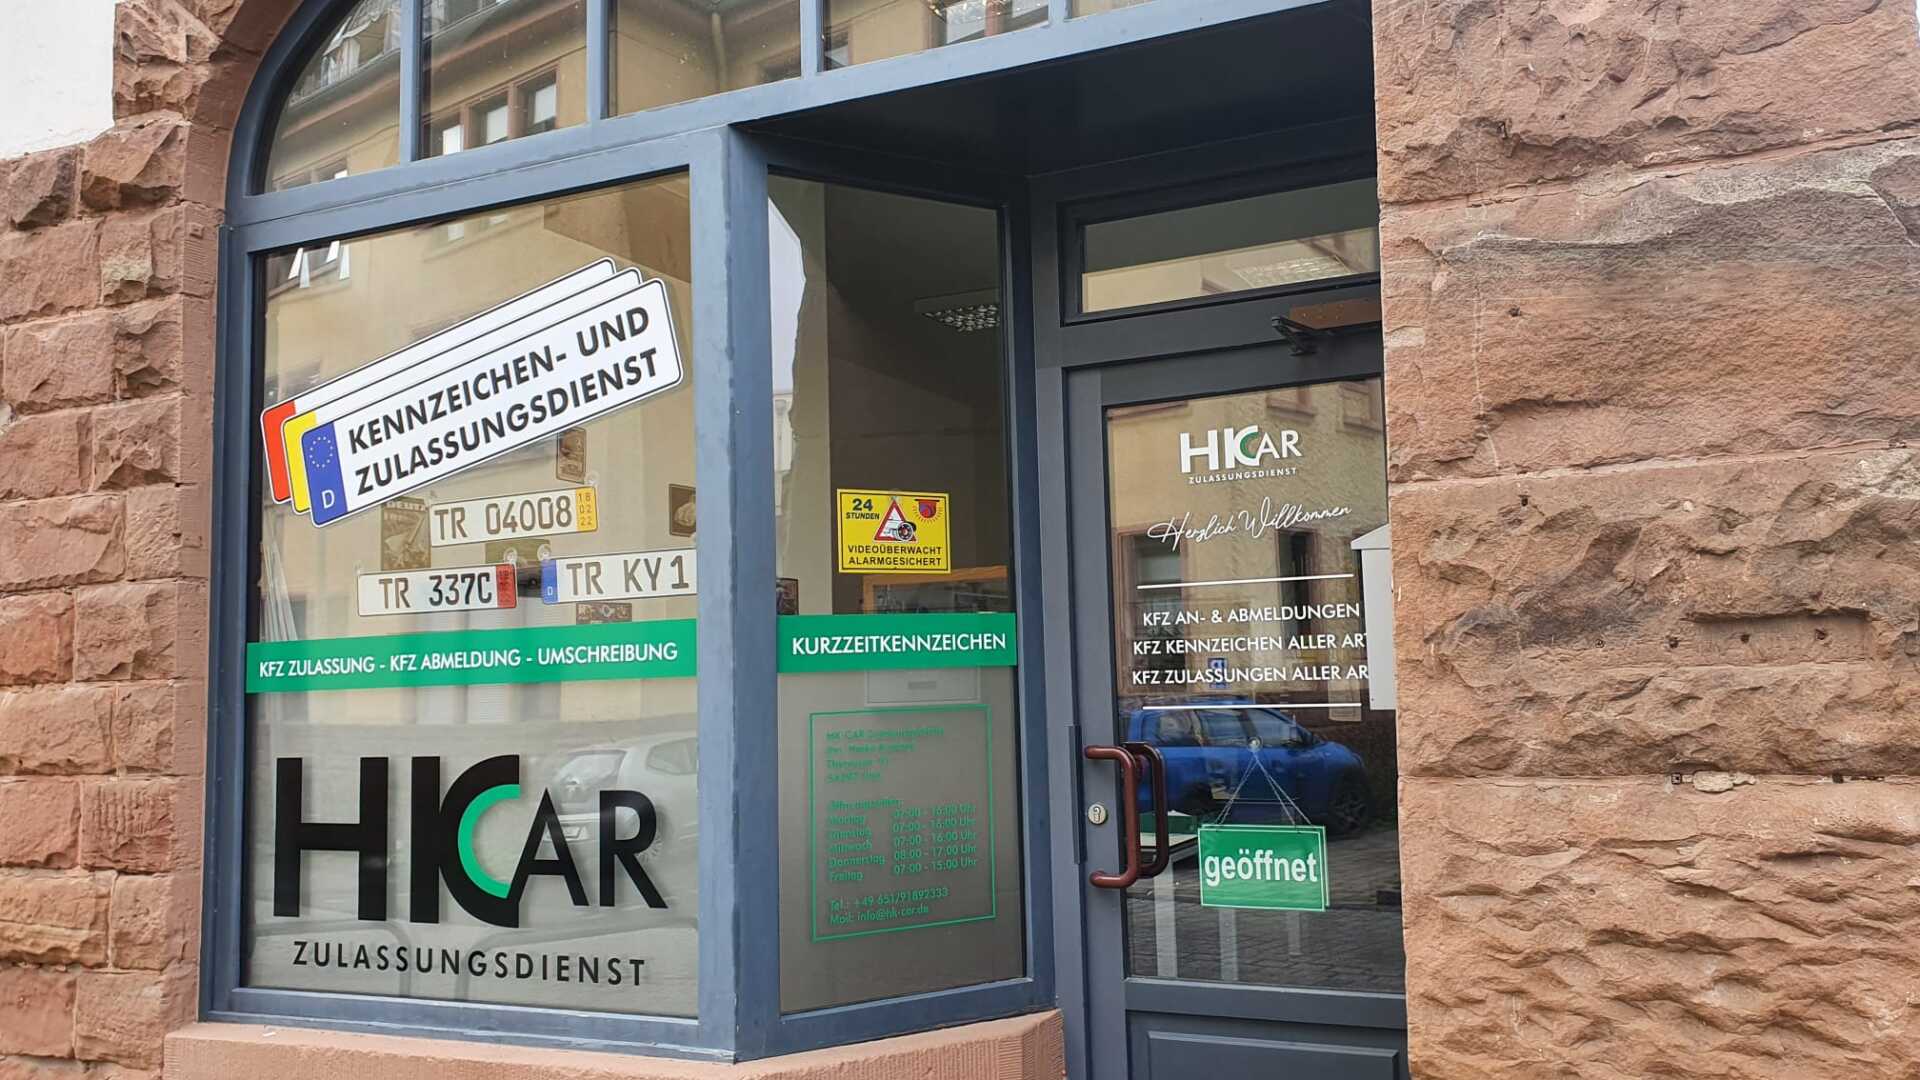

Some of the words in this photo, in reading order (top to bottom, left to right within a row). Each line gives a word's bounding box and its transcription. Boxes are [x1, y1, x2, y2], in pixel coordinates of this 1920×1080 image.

[349, 344, 567, 454] KENNZEICHEN-
[576, 306, 649, 357] UND
[355, 348, 657, 495] ZULASSUNGSDIENST
[1188, 467, 1297, 484] ZULASSUNGSDIENST
[321, 489, 334, 508] D
[852, 498, 873, 512] 24
[434, 508, 467, 540] TR
[486, 495, 573, 535] 04008
[846, 512, 880, 521] STUNDEN
[1147, 512, 1237, 550] Herzlich
[1238, 496, 1352, 539] Willkommen
[848, 544, 942, 555] VIDEOÜBERWACHT
[848, 556, 942, 566] ALARMGESICHERT
[566, 561, 603, 595] TR
[378, 577, 410, 609] TR
[1143, 611, 1171, 627] KFZ
[1174, 609, 1205, 625] AN-
[1211, 609, 1222, 623] &
[1227, 603, 1360, 622] ABMELDUNGEN
[792, 633, 1007, 655] KURZZEITKENNZEICHEN
[1133, 640, 1161, 655] KFZ
[1165, 636, 1282, 654] KENNZEICHEN
[1288, 634, 1337, 650] ALLER
[259, 660, 284, 678] KFZ
[288, 656, 375, 676] ZULASSUNG
[390, 653, 417, 672] KFZ
[421, 648, 521, 671] ABMELDUNG
[537, 642, 678, 665] UMSCHREIBUNG
[1132, 670, 1160, 685] KFZ
[1165, 666, 1286, 684] ZULASSUNGEN
[1292, 665, 1341, 681] ALLER
[1346, 664, 1369, 680] AR
[1203, 847, 1318, 886] geöffnet
[293, 940, 645, 987] ZULASSUNGSDIENST
